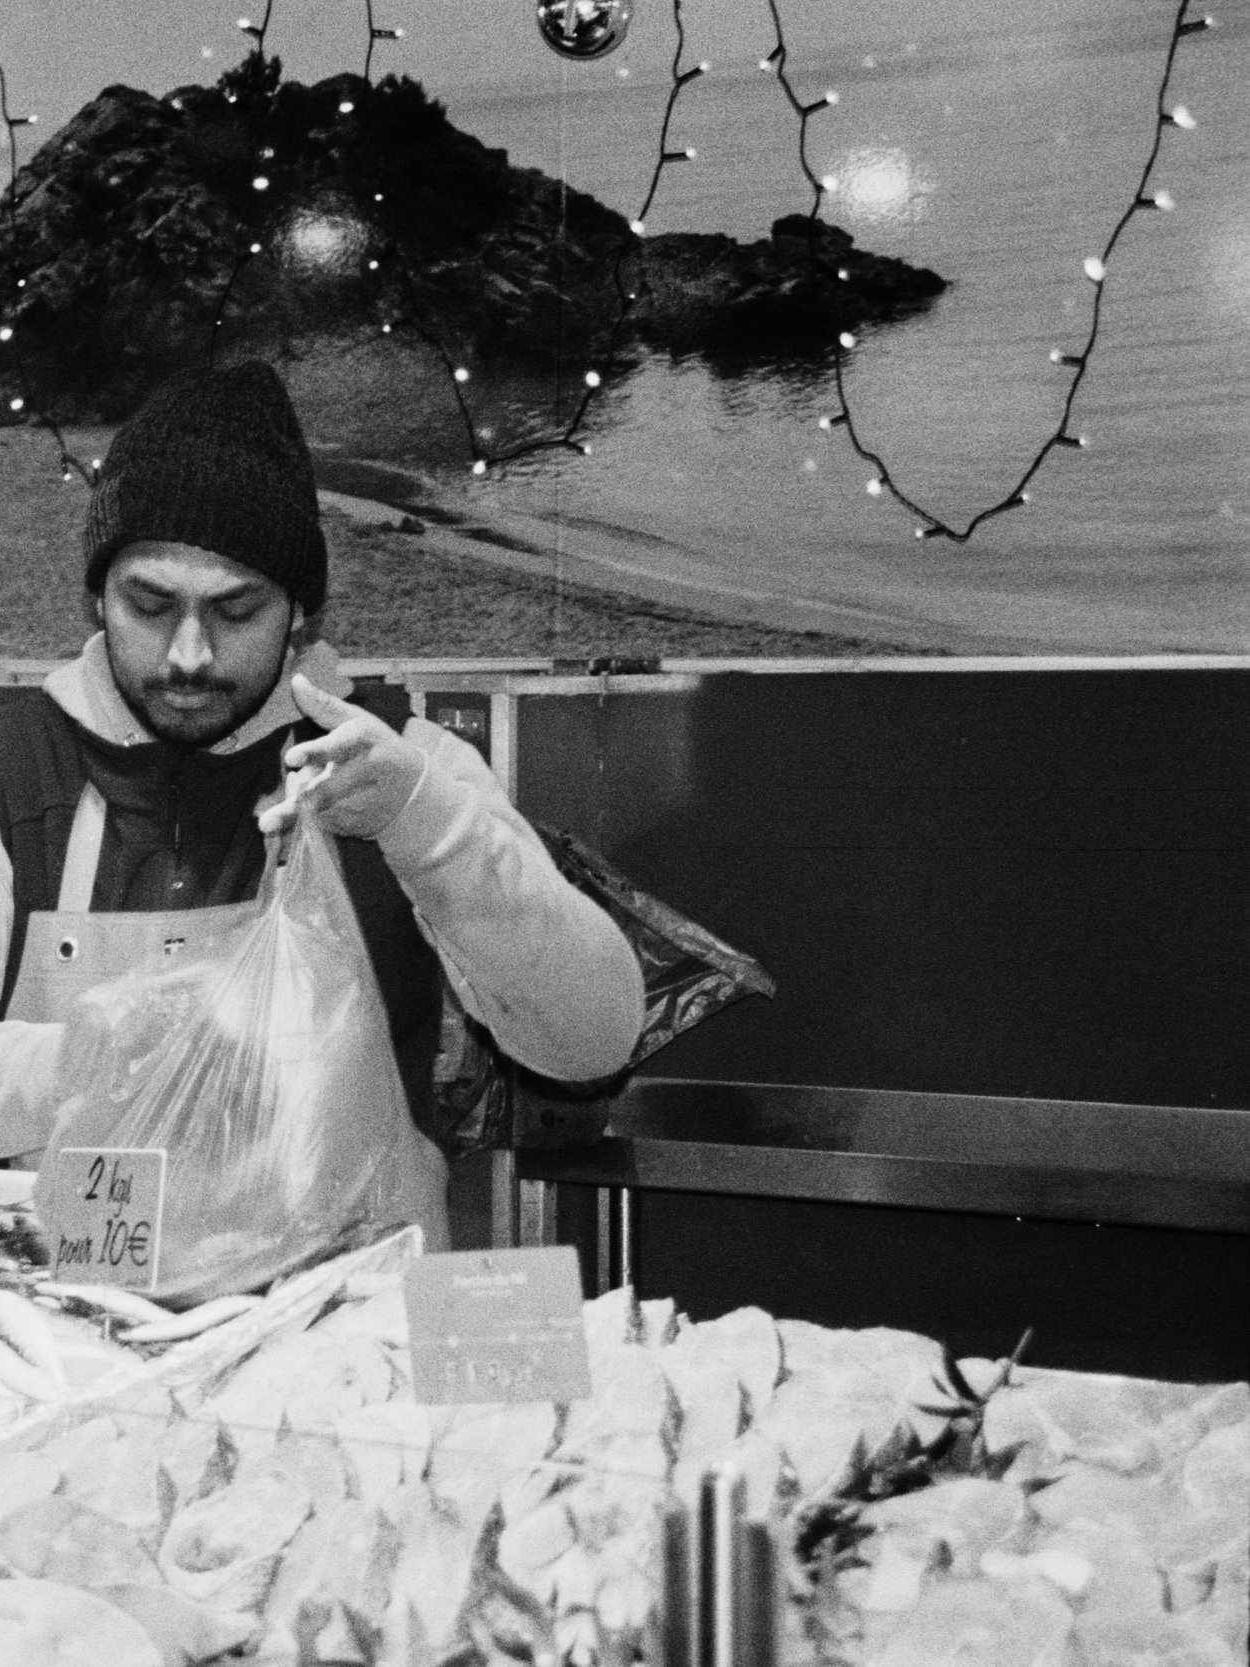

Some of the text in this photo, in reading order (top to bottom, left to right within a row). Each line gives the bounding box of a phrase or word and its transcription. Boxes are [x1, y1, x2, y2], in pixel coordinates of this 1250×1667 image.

[85, 1155, 105, 1201] 2
[54, 1218, 151, 1281] pour 10€
